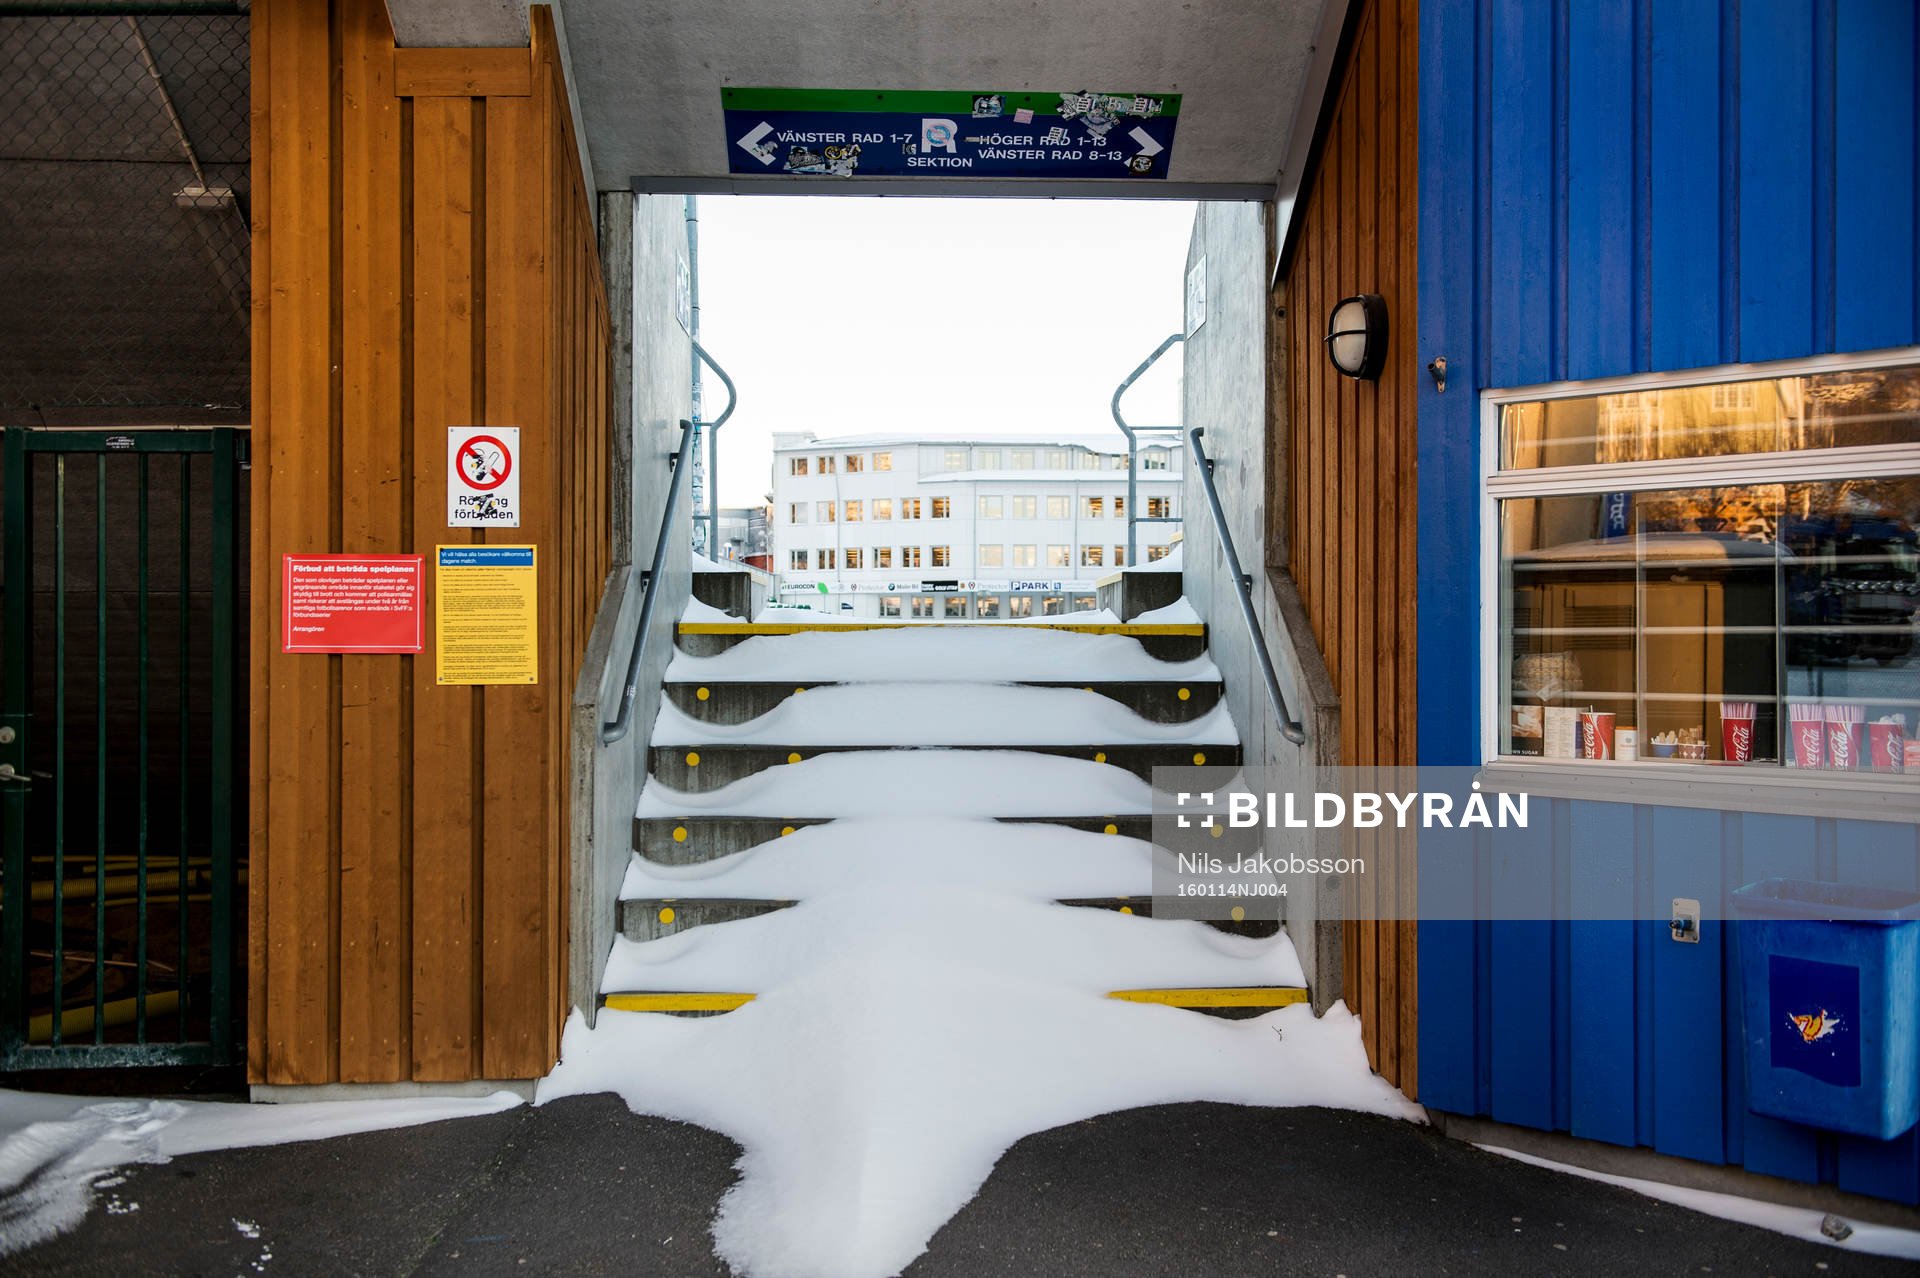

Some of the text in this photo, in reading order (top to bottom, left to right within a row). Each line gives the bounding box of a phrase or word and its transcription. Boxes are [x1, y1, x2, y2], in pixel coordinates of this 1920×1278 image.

[777, 130, 913, 143] VÄNSTER RAD 1-7
[921, 118, 958, 153] R
[979, 133, 1033, 146] HÖGER
[1040, 135, 1071, 146] RAD
[1077, 136, 1107, 147] 1-13
[978, 147, 1123, 161] VÄNSTER RAD 8-13
[907, 157, 973, 167] SEKTION
[459, 495, 508, 508] Röng
[293, 565, 322, 573] Förbud
[336, 565, 368, 573] beträda
[370, 565, 415, 574] spelplanen
[1021, 582, 1049, 590] PARK
[1583, 722, 1595, 760] ca-Cola
[1733, 724, 1750, 762] ca-Cola
